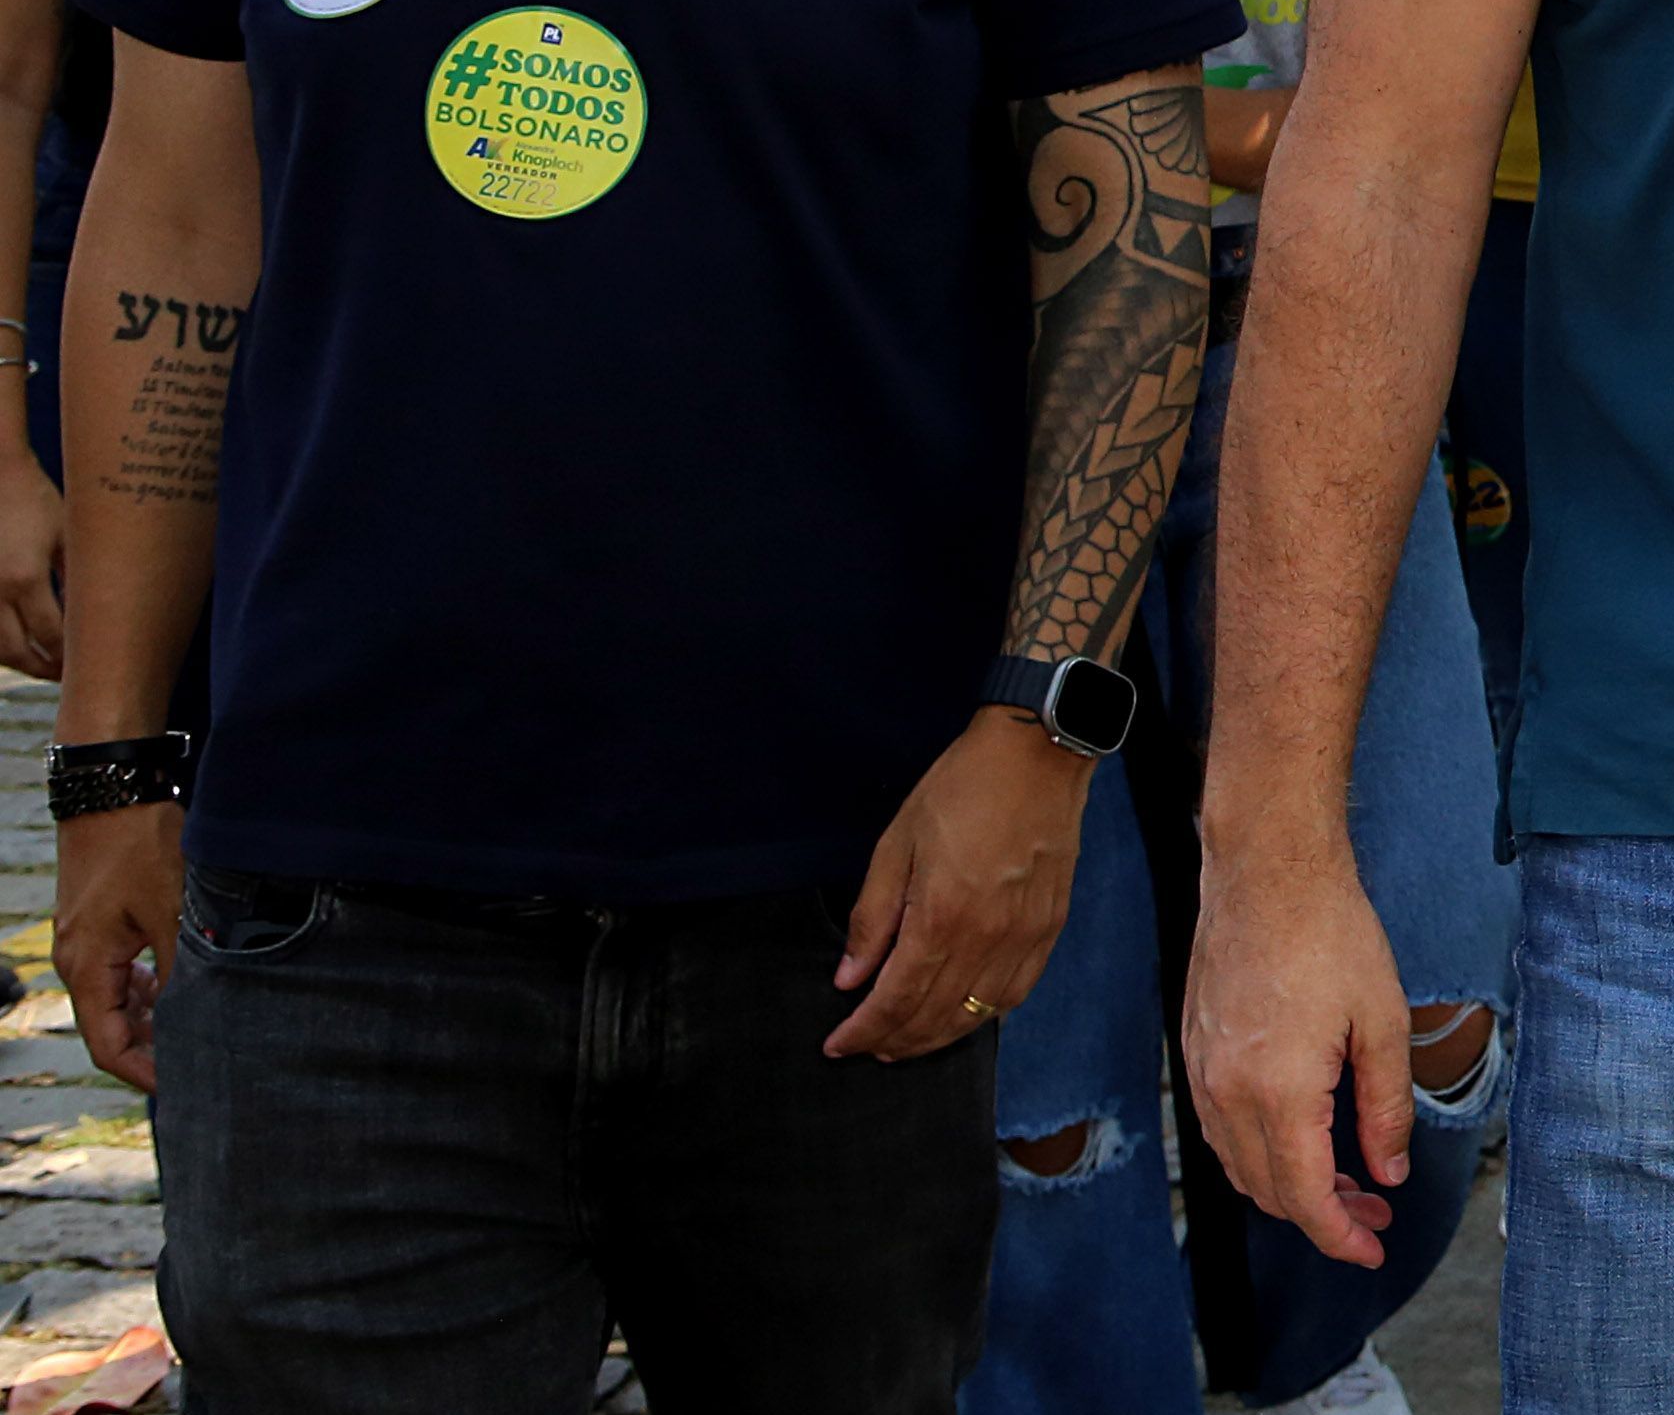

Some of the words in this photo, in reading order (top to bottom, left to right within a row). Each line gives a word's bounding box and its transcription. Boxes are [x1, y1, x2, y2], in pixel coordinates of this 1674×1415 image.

[444, 40, 633, 99] #SOMOS
[497, 80, 626, 125] TODOS
[435, 102, 629, 154] BOLSONARO
[486, 162, 558, 180] VEREADOR
[511, 148, 584, 174] Knoploch
[478, 172, 557, 207] 22722
